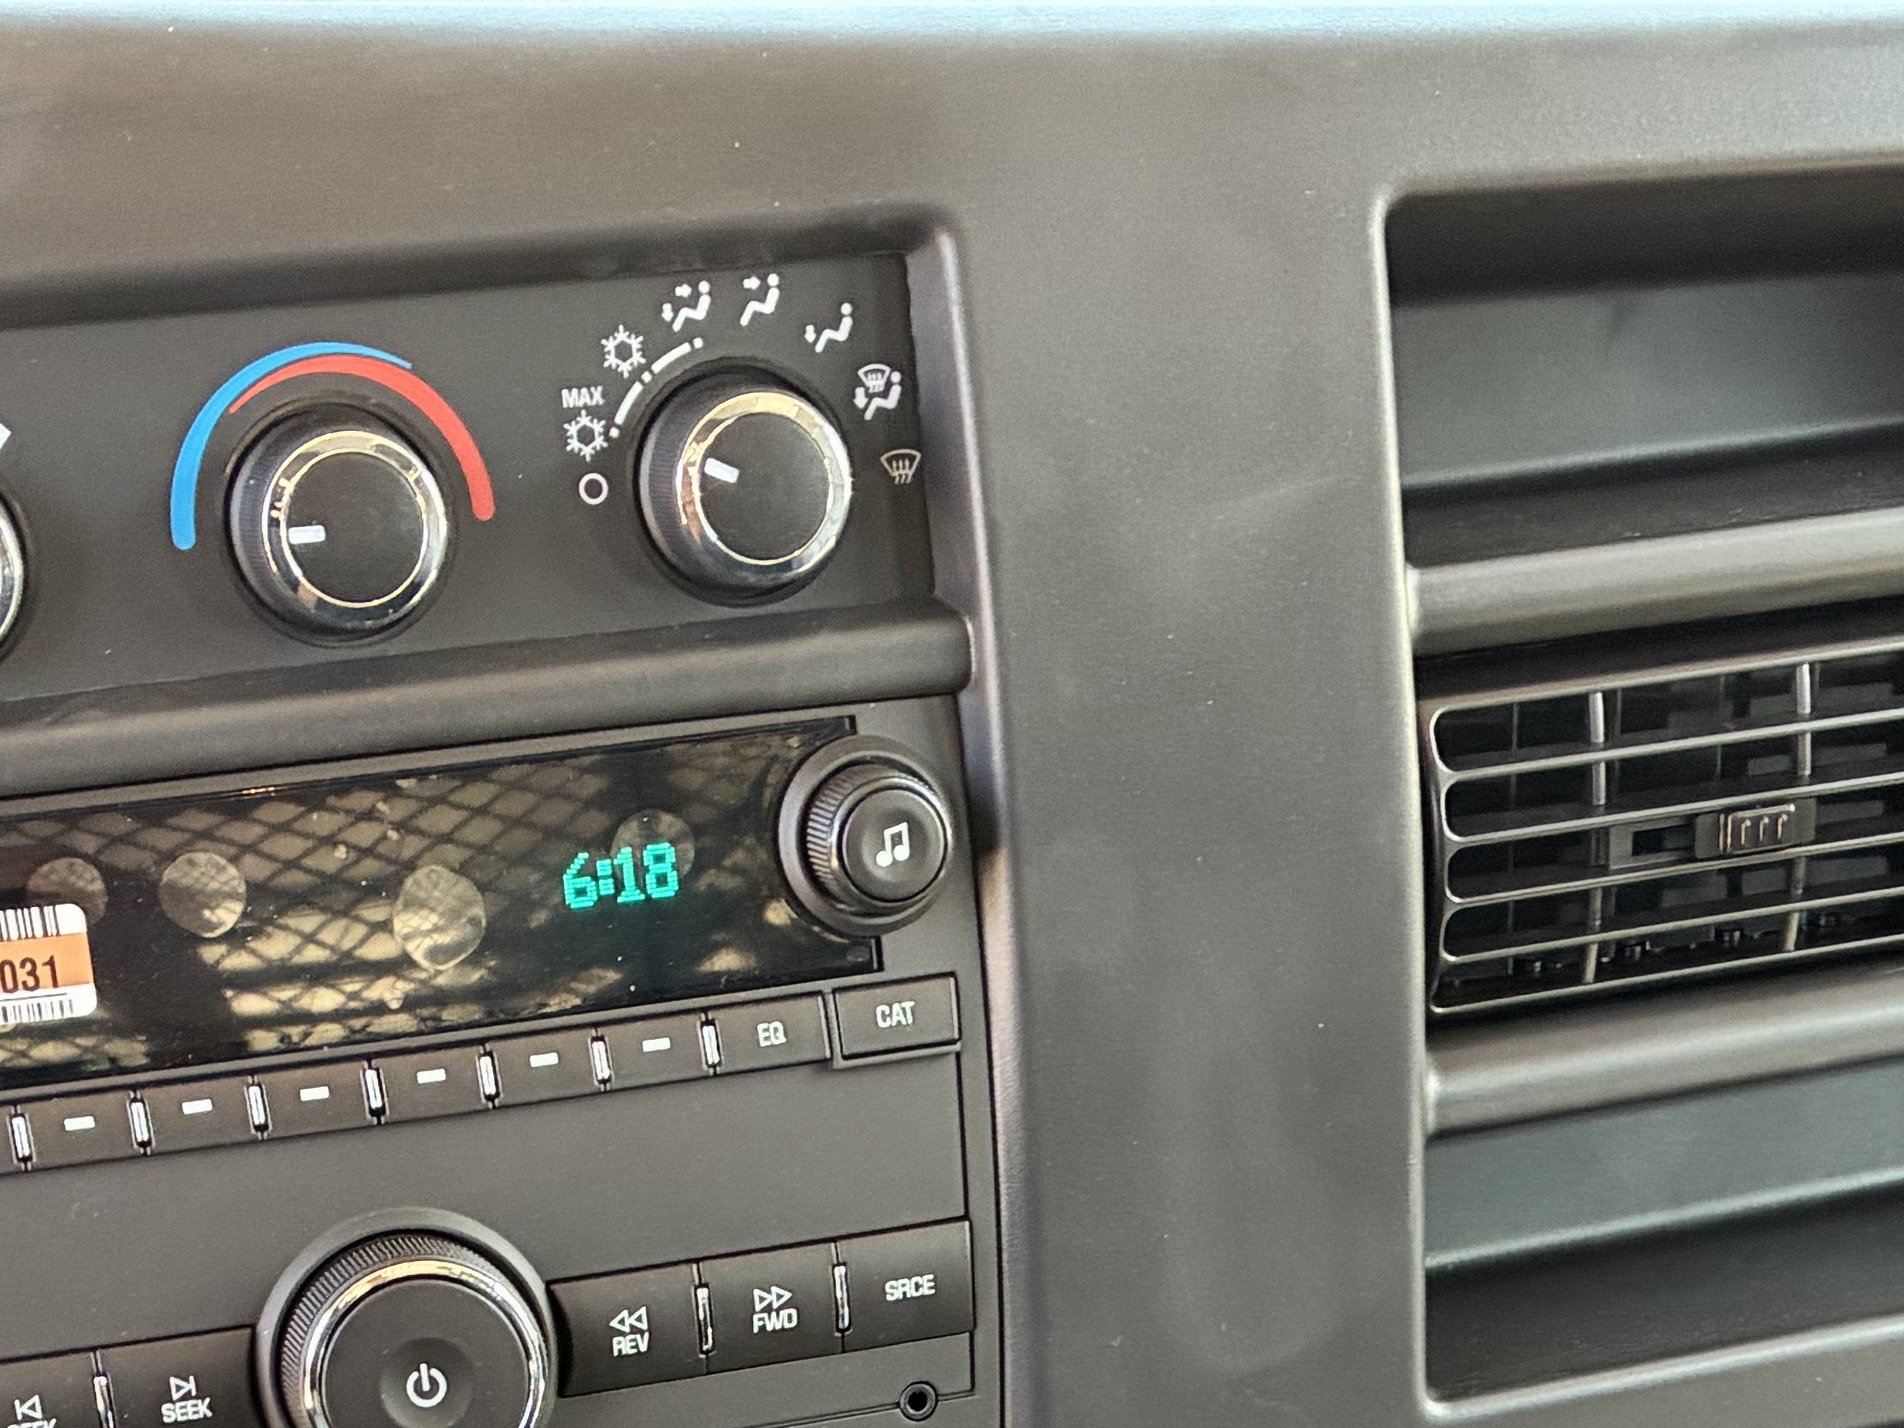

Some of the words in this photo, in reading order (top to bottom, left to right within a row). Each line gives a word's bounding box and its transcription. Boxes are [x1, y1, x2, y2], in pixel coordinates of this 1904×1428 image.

[561, 385, 605, 408] MAX
[563, 842, 679, 909] 6:18
[876, 1001, 915, 1028] CAT
[757, 1021, 787, 1047] EQ
[885, 1274, 936, 1301] SRCE
[753, 1307, 798, 1334] FWD
[612, 1331, 650, 1357] REV
[160, 1397, 213, 1424] SEEK
